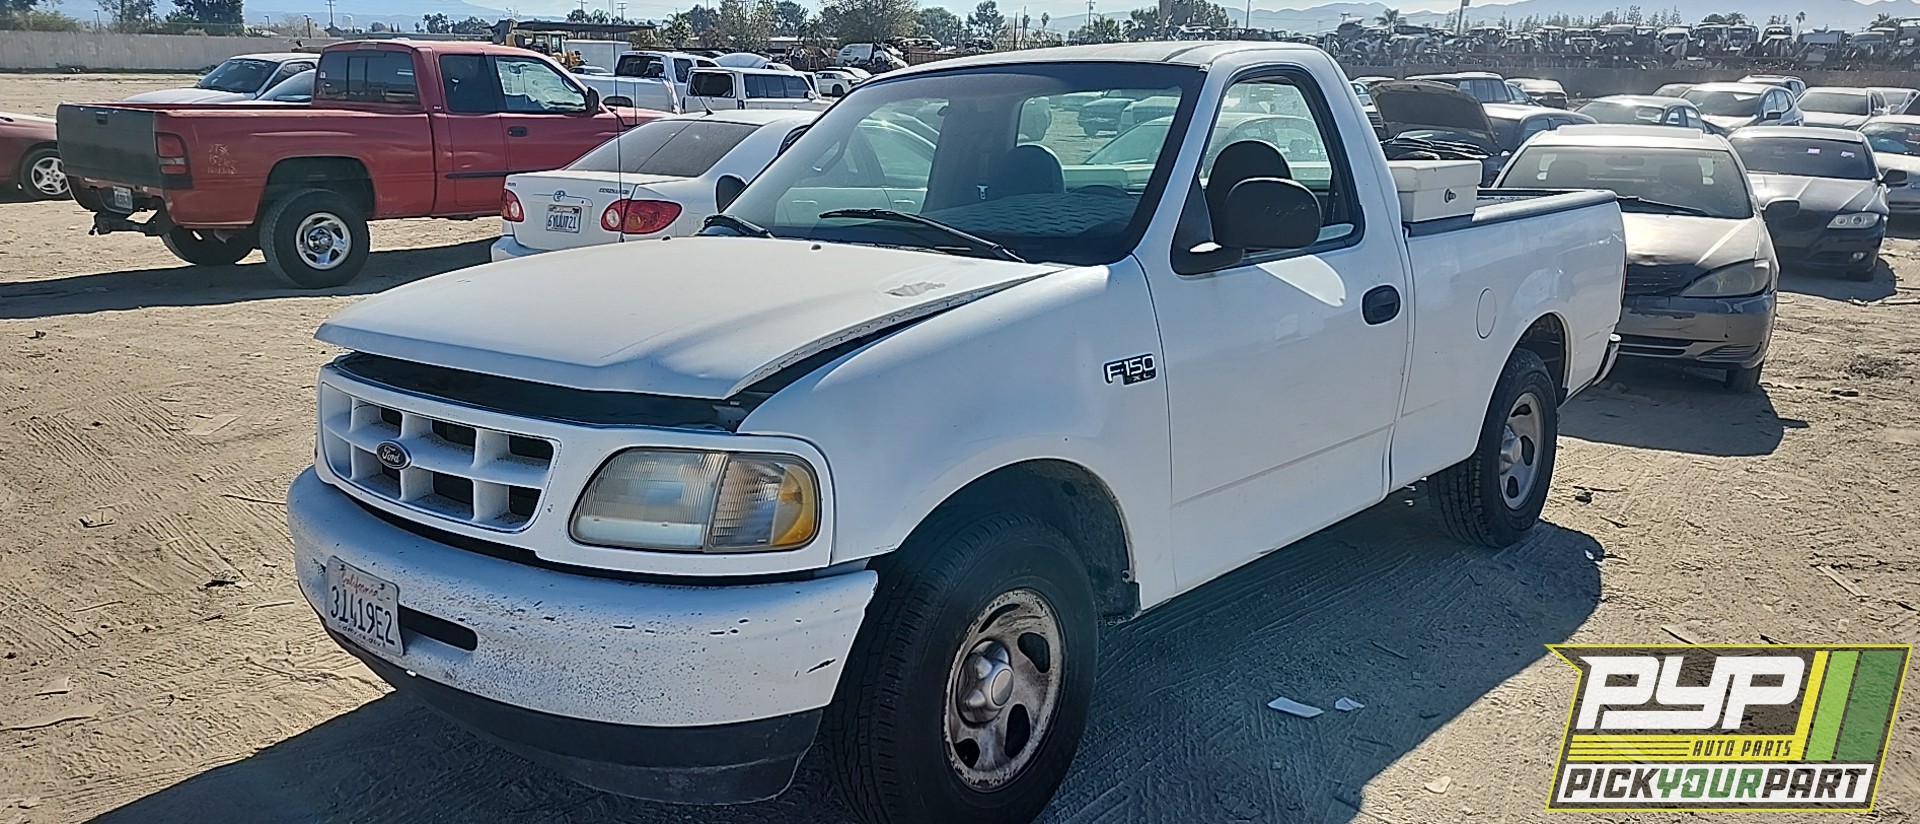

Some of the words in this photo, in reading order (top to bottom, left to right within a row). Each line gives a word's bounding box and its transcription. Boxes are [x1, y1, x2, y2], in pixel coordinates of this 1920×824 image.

[1132, 373, 1152, 381] XL
[382, 445, 401, 463] Ford
[341, 570, 379, 597] California
[330, 585, 396, 646] 31419E2
